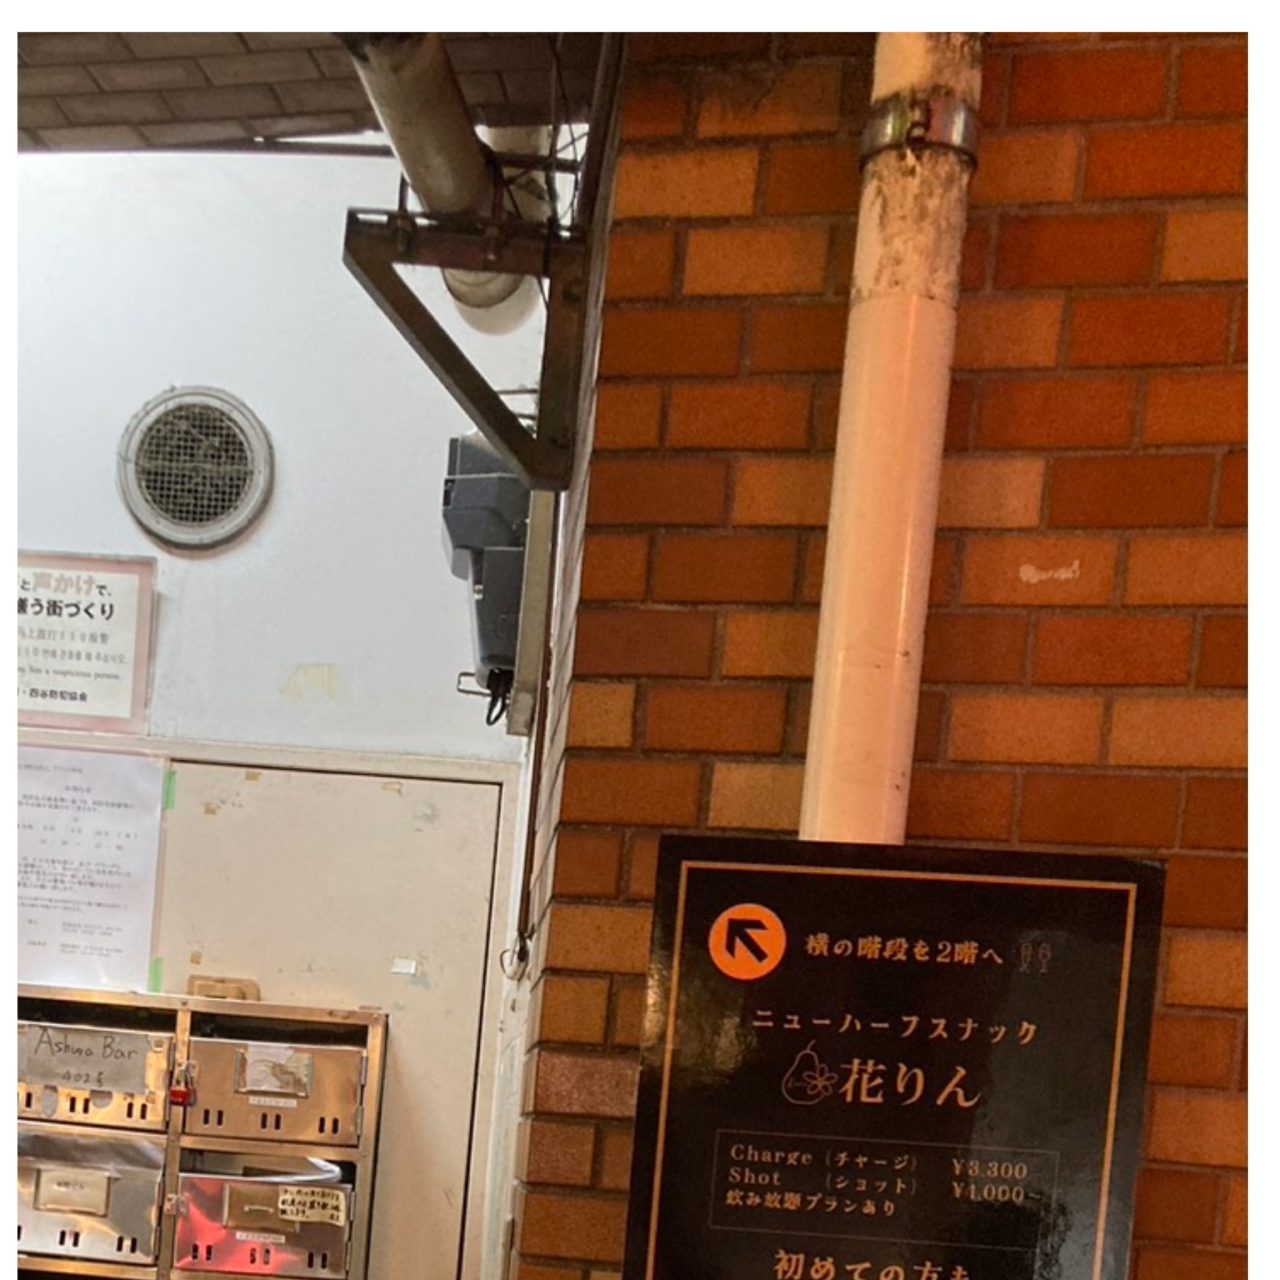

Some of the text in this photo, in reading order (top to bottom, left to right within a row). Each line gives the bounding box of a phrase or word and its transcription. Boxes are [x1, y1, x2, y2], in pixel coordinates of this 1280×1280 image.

[753, 1008, 1038, 1046] ニューハーフスナック
[102, 1035, 138, 1059] Bar
[838, 1057, 983, 1107] 花りん
[729, 1143, 814, 1169] Charge
[727, 1167, 782, 1187] Shot
[725, 1188, 897, 1218] 飲み放題プランあり
